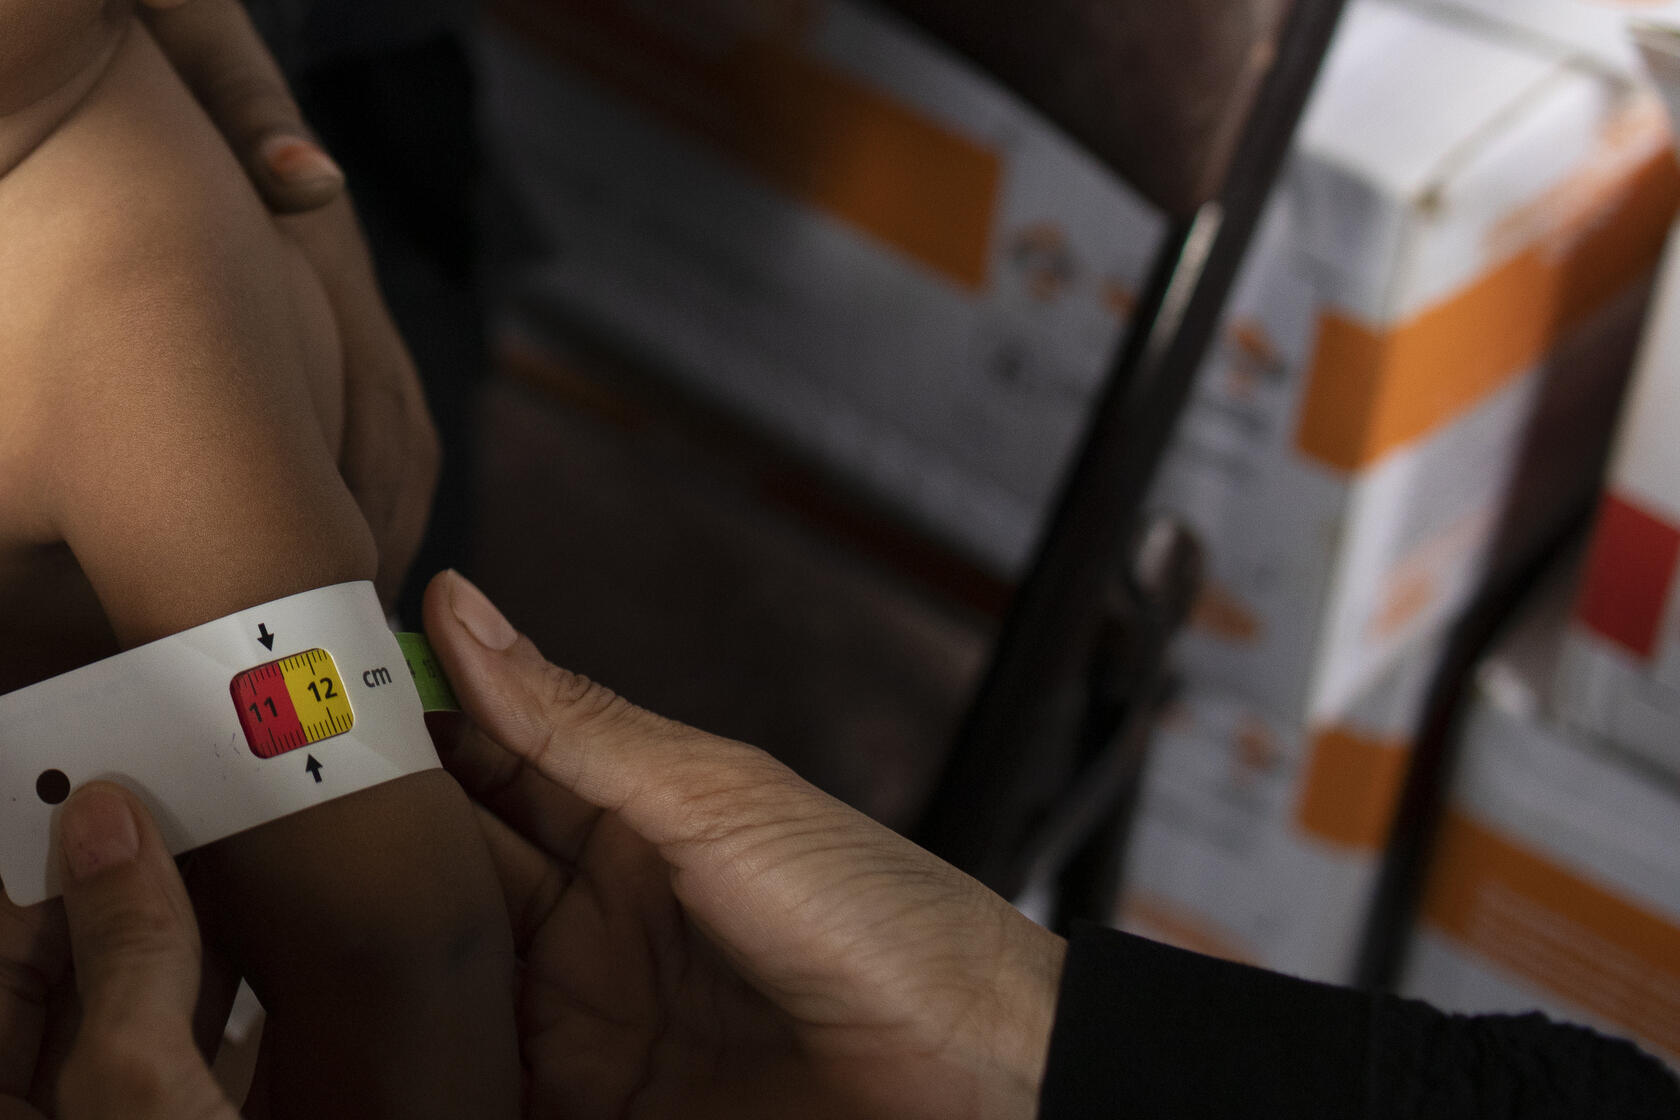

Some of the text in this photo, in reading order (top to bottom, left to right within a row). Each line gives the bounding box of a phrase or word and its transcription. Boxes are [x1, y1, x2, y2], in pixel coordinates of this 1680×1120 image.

[363, 667, 392, 688] cm
[249, 677, 338, 723] 11 12
